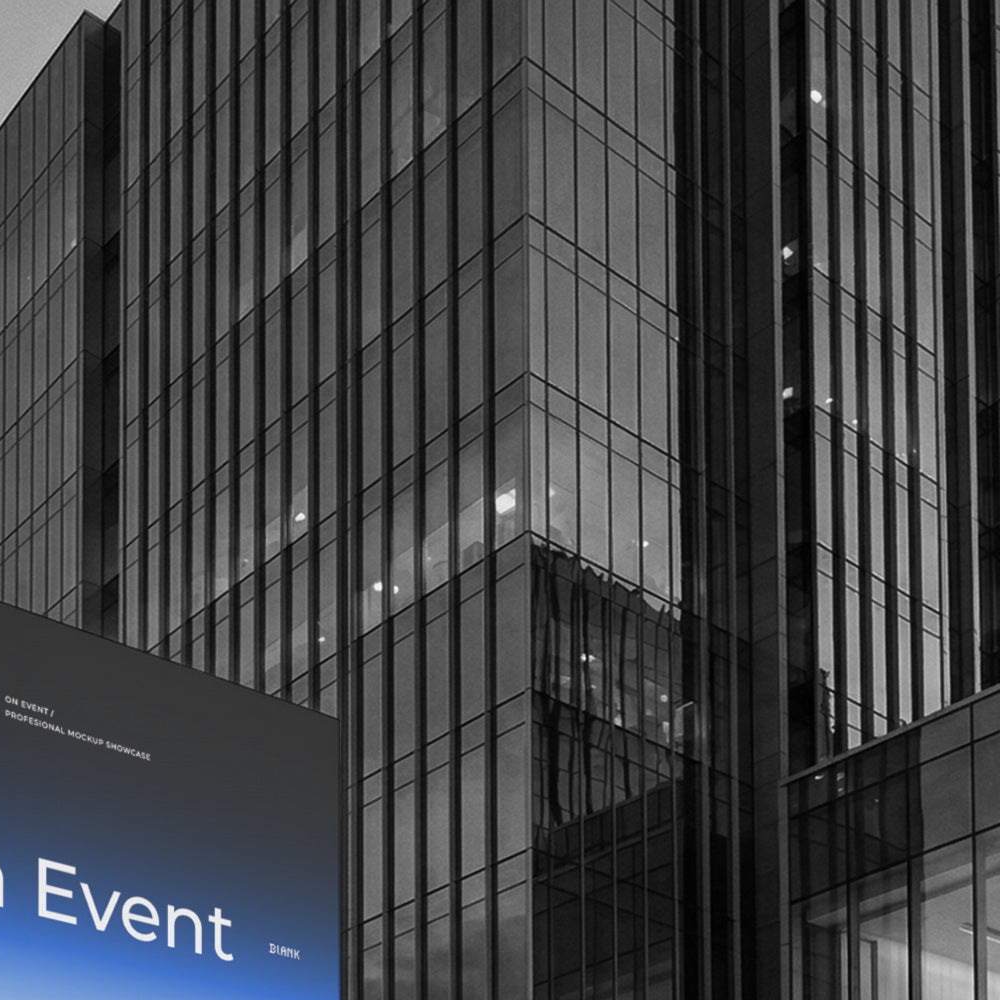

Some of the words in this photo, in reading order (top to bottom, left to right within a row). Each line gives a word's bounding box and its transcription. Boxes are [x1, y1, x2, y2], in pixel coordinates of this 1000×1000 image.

[4, 695, 19, 706] ON
[20, 700, 49, 716] EVENT
[4, 709, 66, 735] PROFESIONAL
[67, 729, 104, 746] MOCKUP
[105, 741, 151, 762] SHOWCASE
[38, 857, 234, 962] Event
